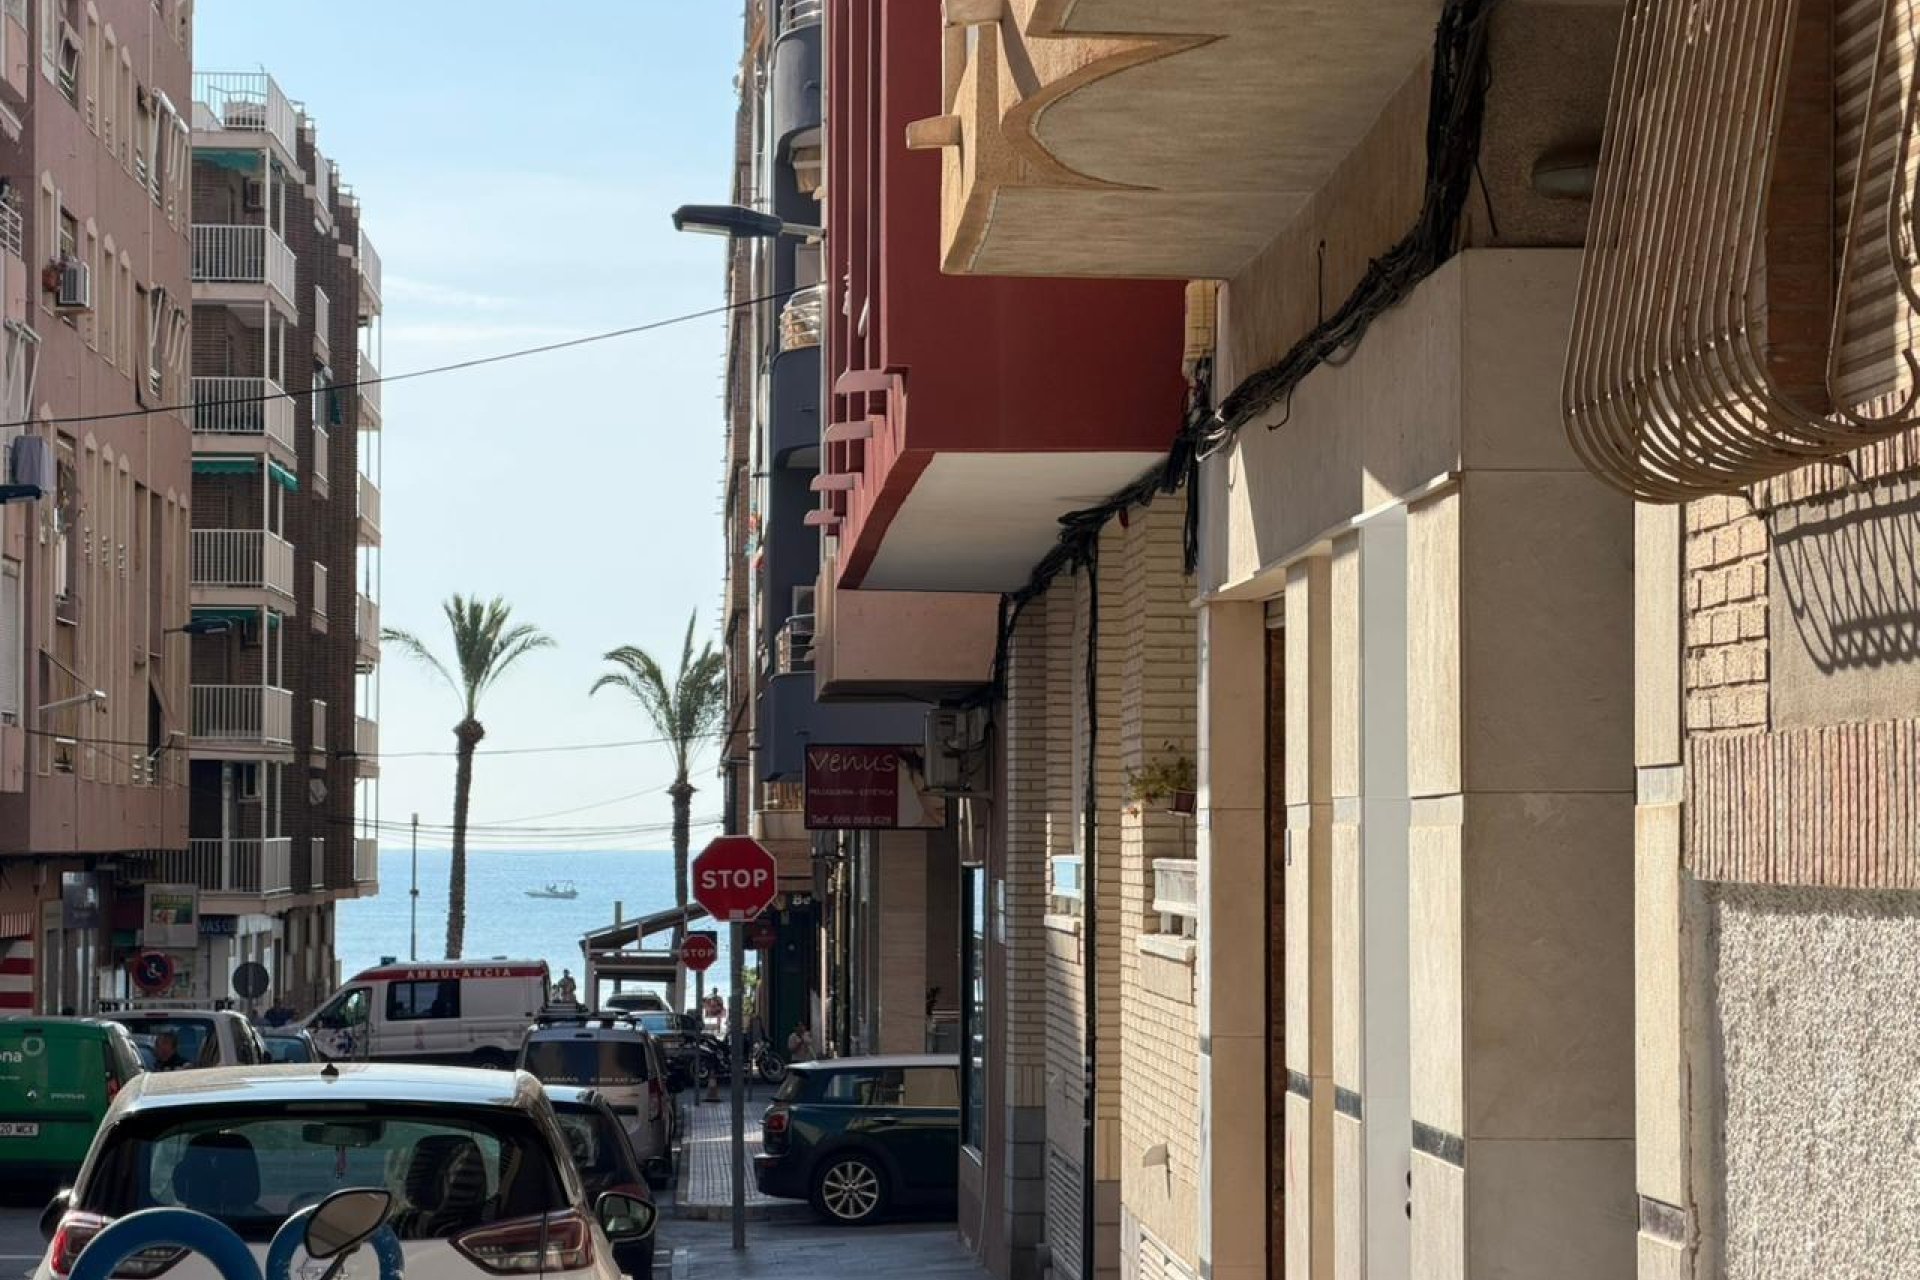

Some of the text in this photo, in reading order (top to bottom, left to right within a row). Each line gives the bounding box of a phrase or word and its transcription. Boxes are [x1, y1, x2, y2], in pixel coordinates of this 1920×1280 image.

[809, 751, 897, 773] Venus
[702, 869, 768, 889] STOP
[682, 948, 714, 958] STOP
[407, 967, 511, 979] AMBULANCIA
[0, 1050, 22, 1063] na
